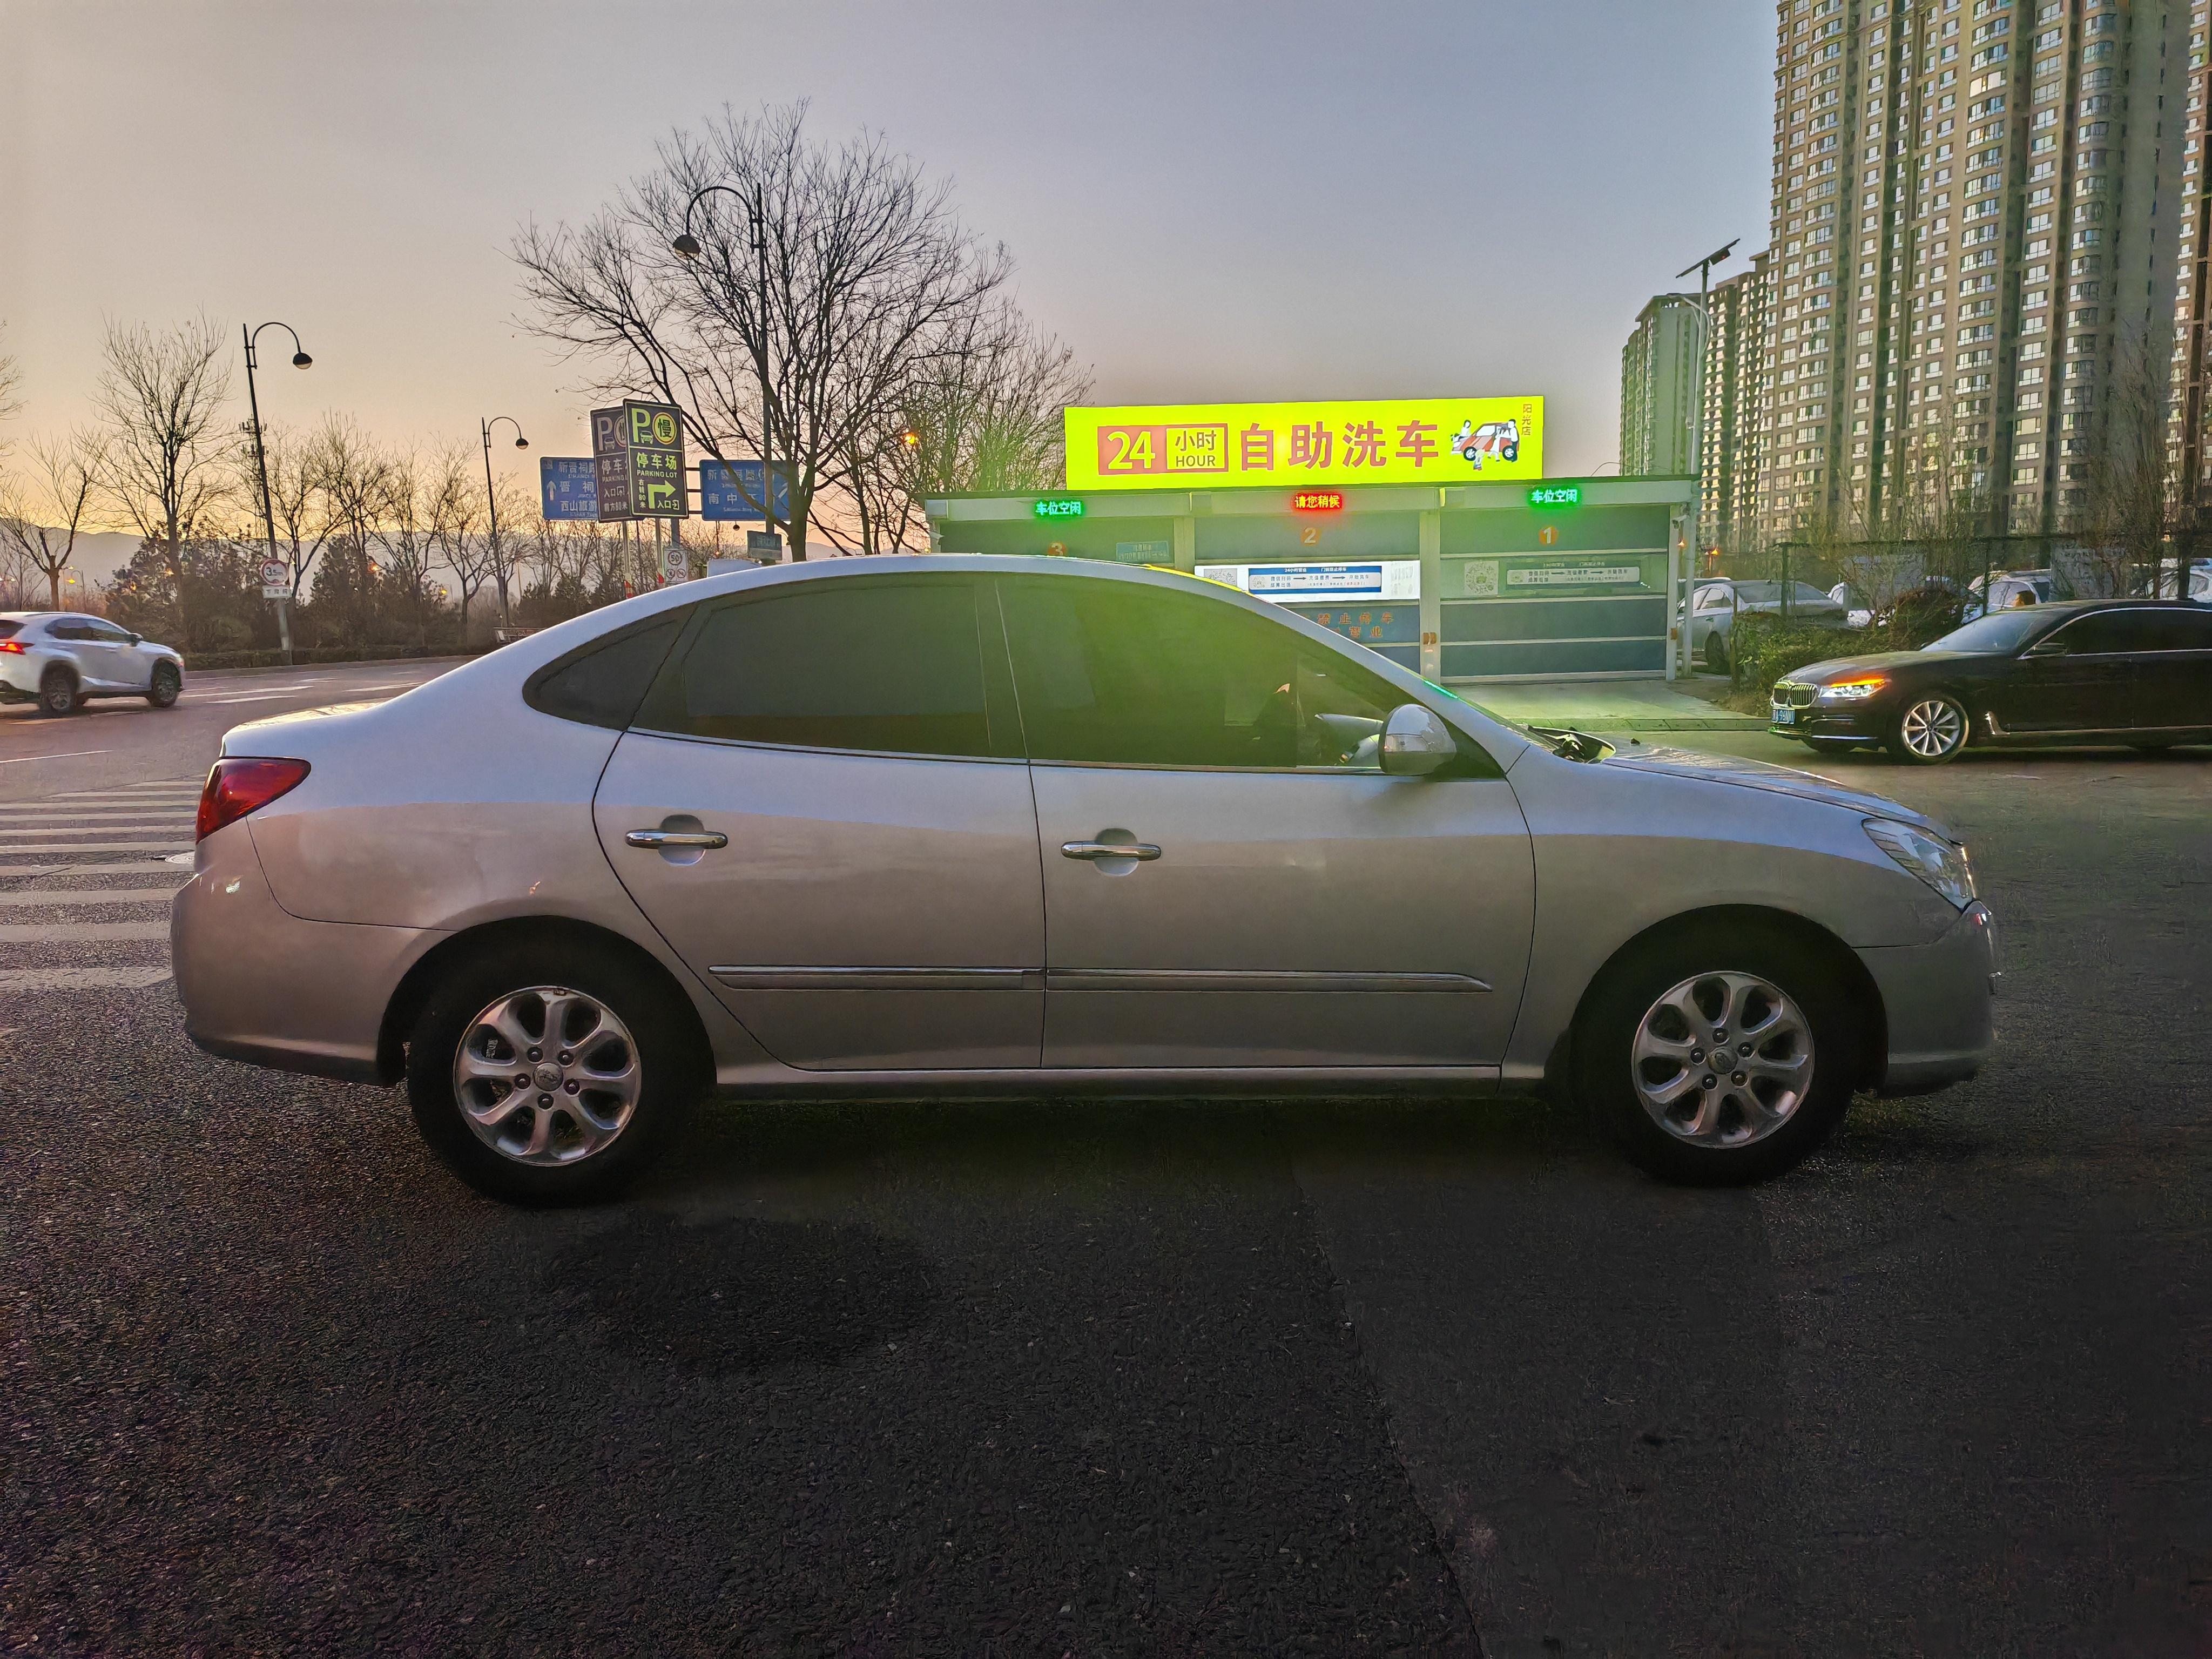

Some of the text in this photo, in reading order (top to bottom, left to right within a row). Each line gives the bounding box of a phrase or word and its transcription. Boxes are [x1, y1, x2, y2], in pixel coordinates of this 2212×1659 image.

[631, 408, 651, 443] P
[1521, 403, 1532, 435] 阳光店
[597, 416, 613, 451] P
[658, 418, 672, 438] 慢
[1175, 430, 1217, 451] 小时
[1240, 420, 1439, 471] 自助洗车
[1107, 431, 1156, 469] 24
[602, 458, 628, 475] 停车
[636, 452, 677, 470] 停车场
[1176, 455, 1216, 467] HOUR
[637, 469, 664, 477] PARKING
[604, 488, 616, 498] 入口
[1294, 495, 1340, 508] 请您稍候
[1530, 488, 1577, 504] 车位空闲
[657, 500, 671, 509] 入口
[1035, 501, 1082, 516] 车位空闲
[1304, 527, 1316, 543] 2
[1543, 527, 1552, 544] 1
[1051, 542, 1063, 556] 3
